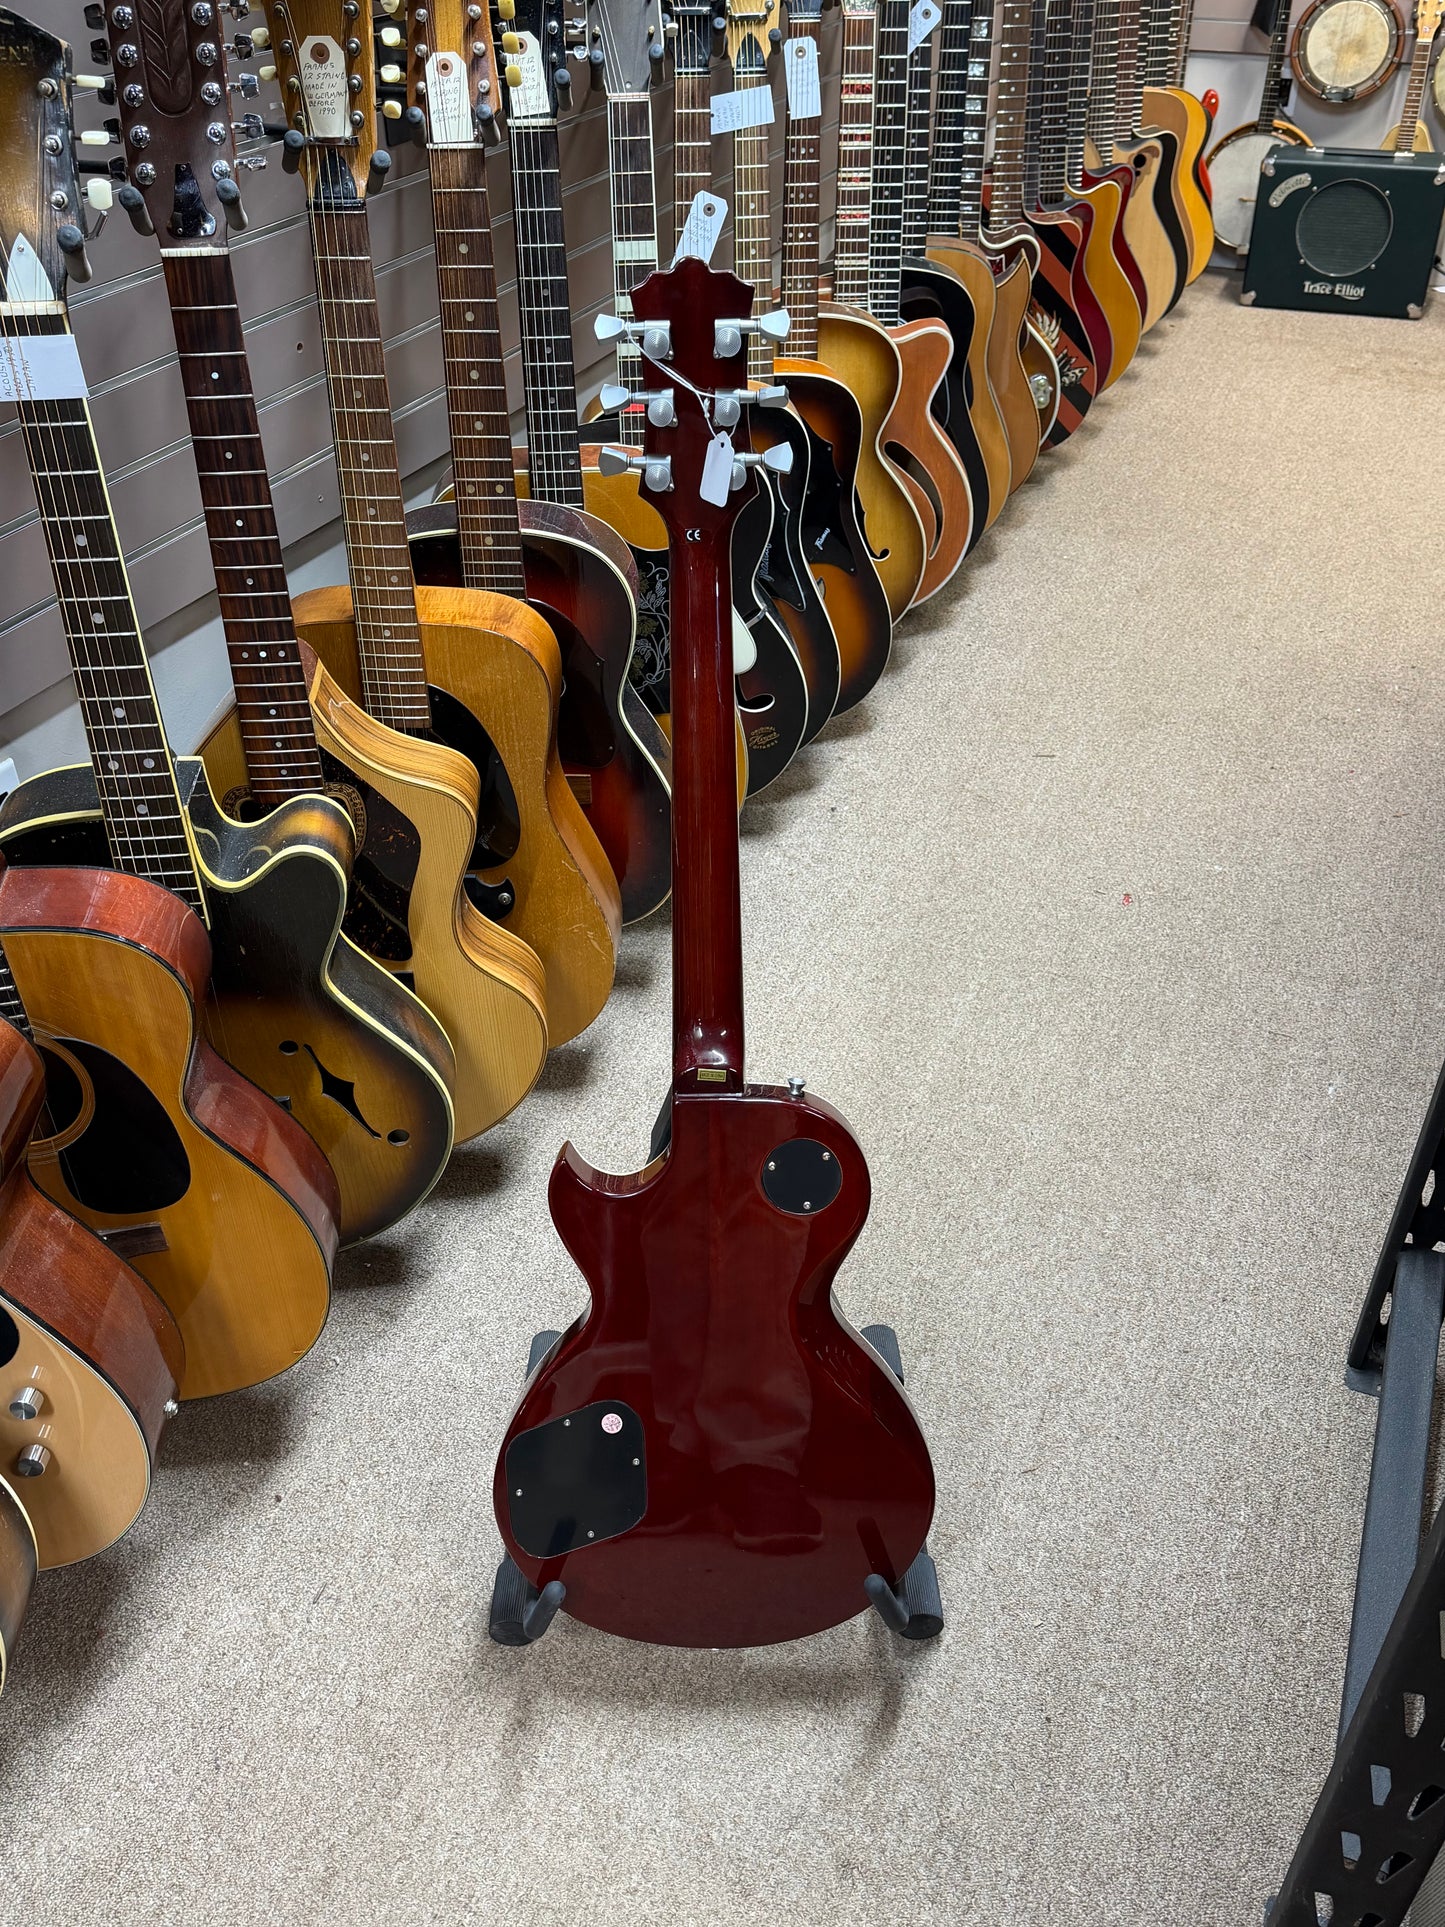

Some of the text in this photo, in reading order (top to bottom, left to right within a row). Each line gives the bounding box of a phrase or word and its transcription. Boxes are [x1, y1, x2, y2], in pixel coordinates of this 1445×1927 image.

[304, 71, 345, 80] 12 STRING
[305, 81, 338, 91] MADE IN
[309, 99, 335, 107] BEFORE
[1303, 281, 1366, 300] Trace Elliot
